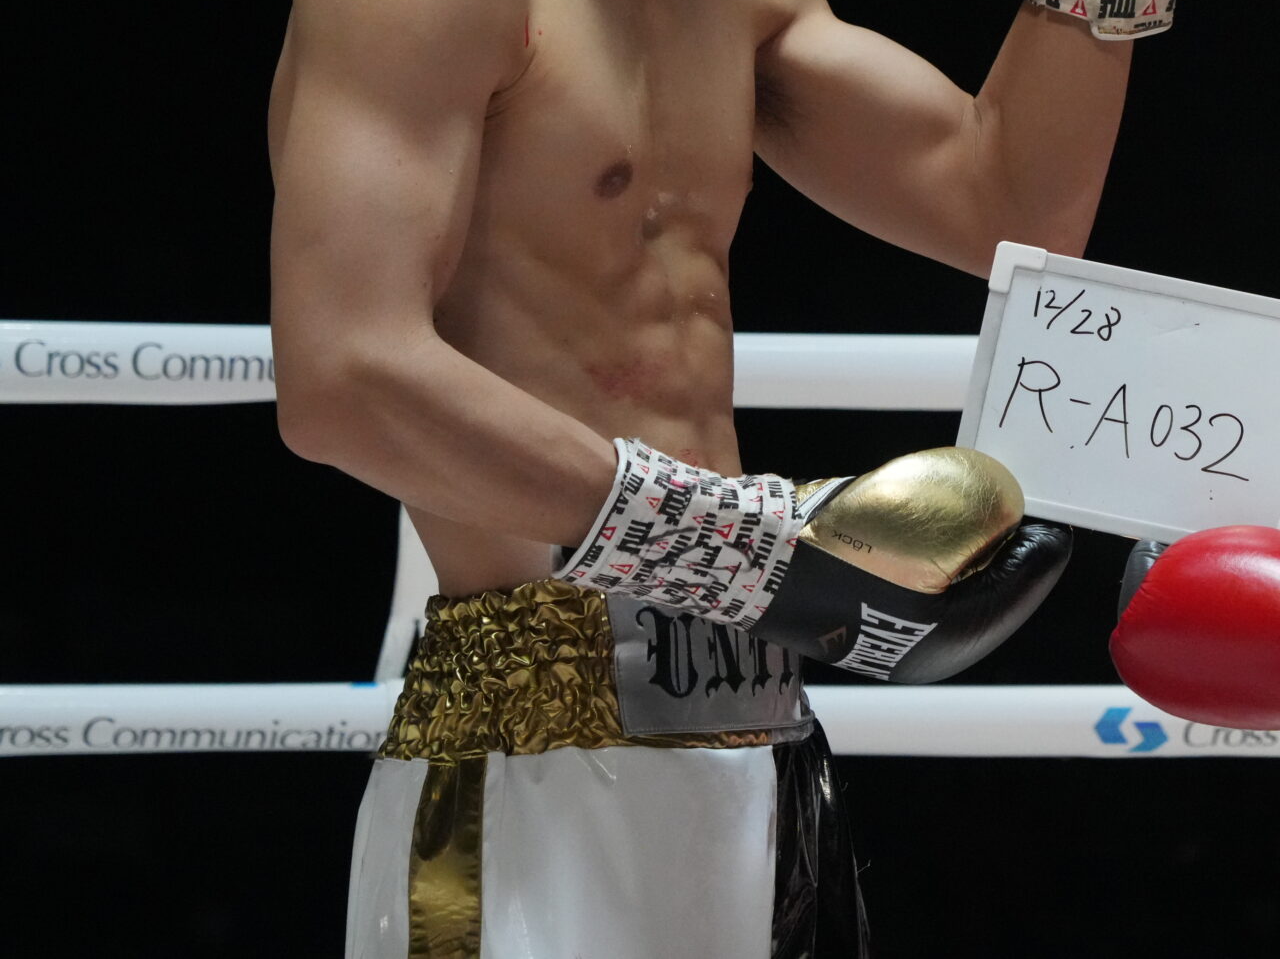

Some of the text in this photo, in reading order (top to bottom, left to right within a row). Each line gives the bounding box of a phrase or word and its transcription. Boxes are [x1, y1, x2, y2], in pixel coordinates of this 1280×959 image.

[1033, 288, 1122, 341] 12/28
[14, 339, 275, 382] Cross Comm
[831, 530, 872, 554] LOCK
